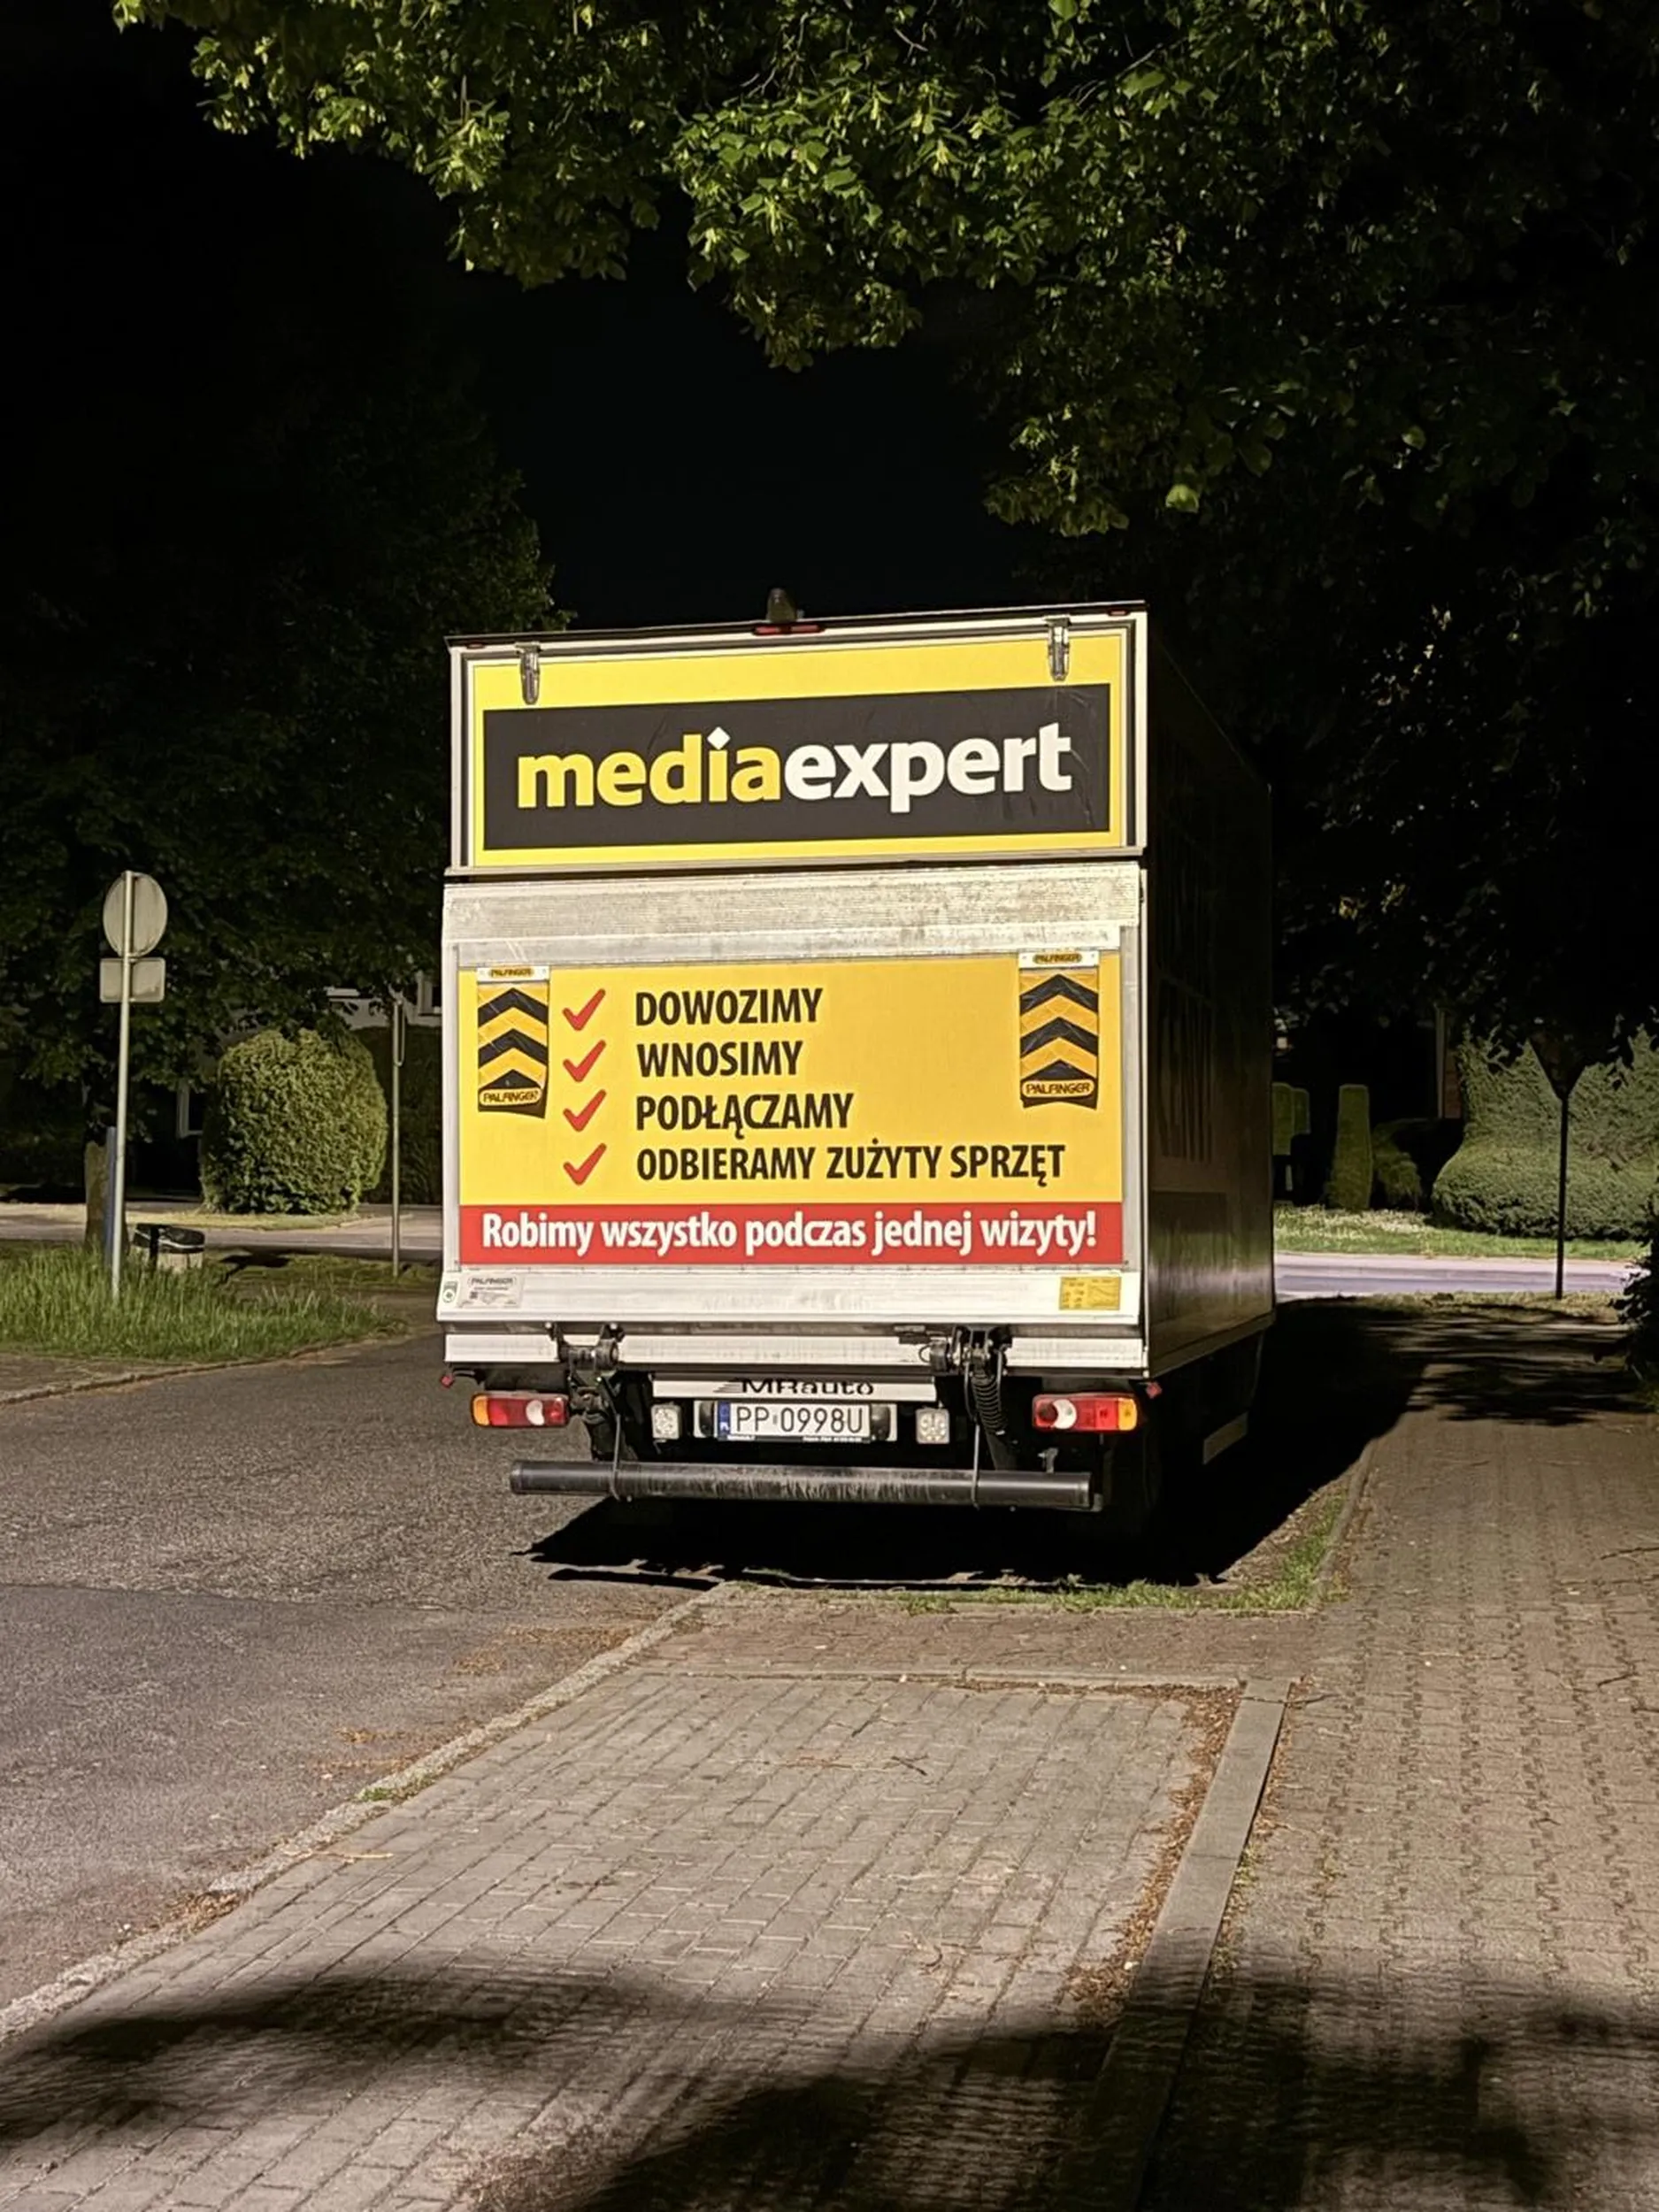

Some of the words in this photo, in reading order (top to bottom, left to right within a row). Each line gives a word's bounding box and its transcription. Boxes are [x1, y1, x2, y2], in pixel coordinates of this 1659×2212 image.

[636, 988, 823, 1026] DOWOZIMY
[636, 1041, 803, 1078] WNOSIMY
[636, 1093, 854, 1140] PODŁĄCZAMY
[636, 1147, 816, 1180] ODBIERAMY
[826, 1138, 943, 1179] ZUŻYTY
[950, 1145, 1065, 1187] SPRZĘT
[482, 1211, 594, 1257] Robimy
[601, 1211, 737, 1257] wszystko
[745, 1210, 867, 1256] podczas
[872, 1210, 972, 1256] jednej
[981, 1210, 1096, 1256] wizyty!
[736, 1407, 769, 1432] PP
[780, 1408, 863, 1433] 0998U
